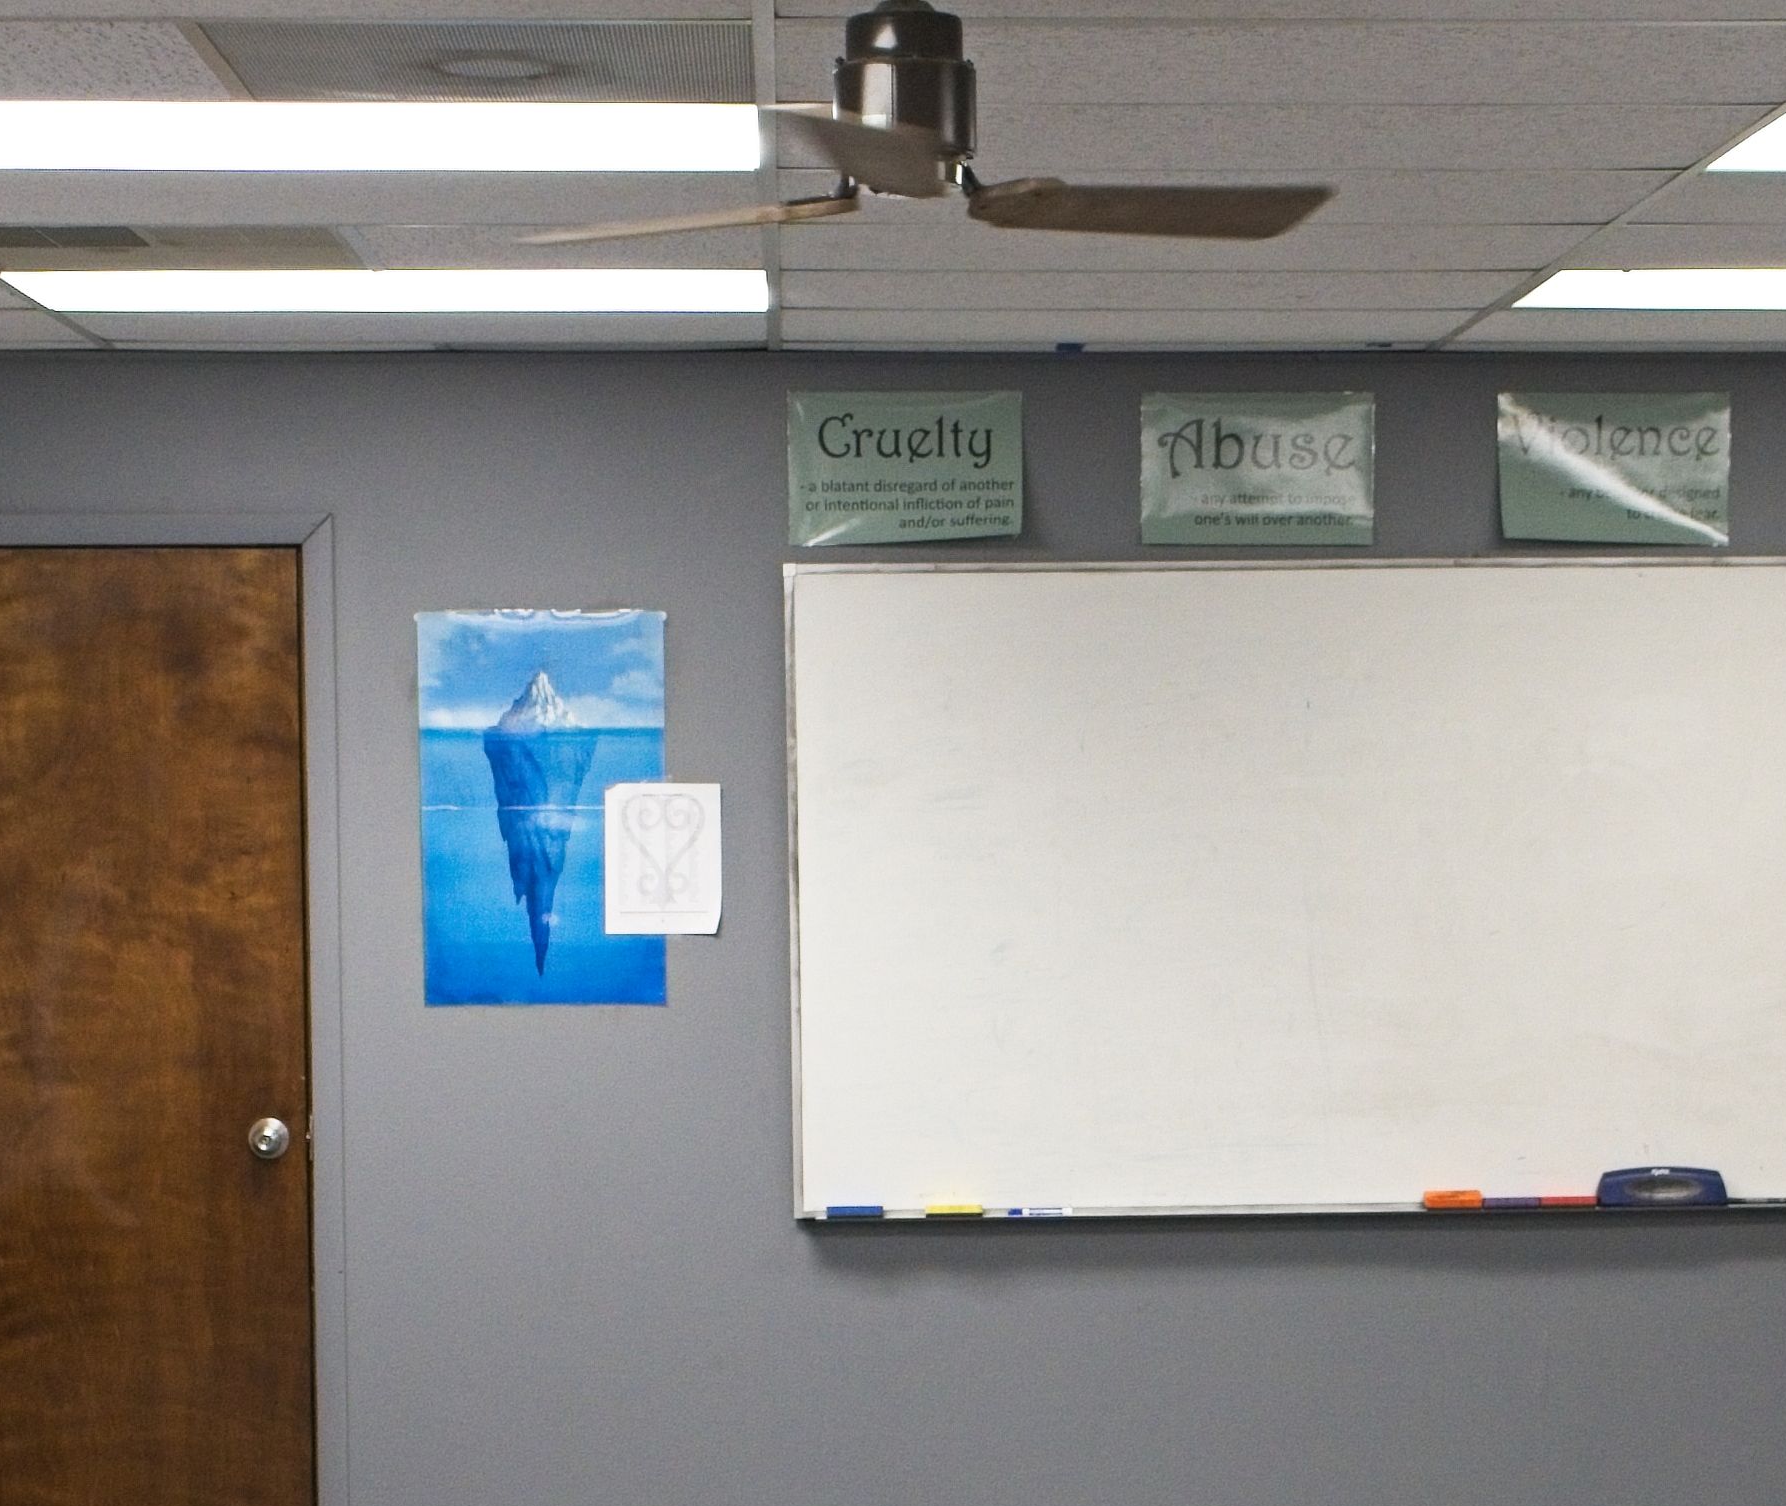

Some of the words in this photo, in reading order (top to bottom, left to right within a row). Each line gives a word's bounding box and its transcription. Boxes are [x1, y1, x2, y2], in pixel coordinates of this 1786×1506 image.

[817, 412, 993, 469] Cruelty
[1157, 417, 1357, 479] Abuse
[820, 479, 870, 493] blatant
[873, 479, 938, 495] disregard
[941, 479, 955, 492] of
[959, 479, 1015, 492] another
[805, 500, 819, 512] or
[824, 498, 899, 511] intentional
[902, 497, 963, 511] infliction
[966, 497, 980, 510] of
[984, 497, 1015, 513] pain
[898, 515, 945, 530] and/or
[1194, 512, 1232, 527] one's
[1235, 513, 1260, 526] will
[1262, 515, 1293, 527] over
